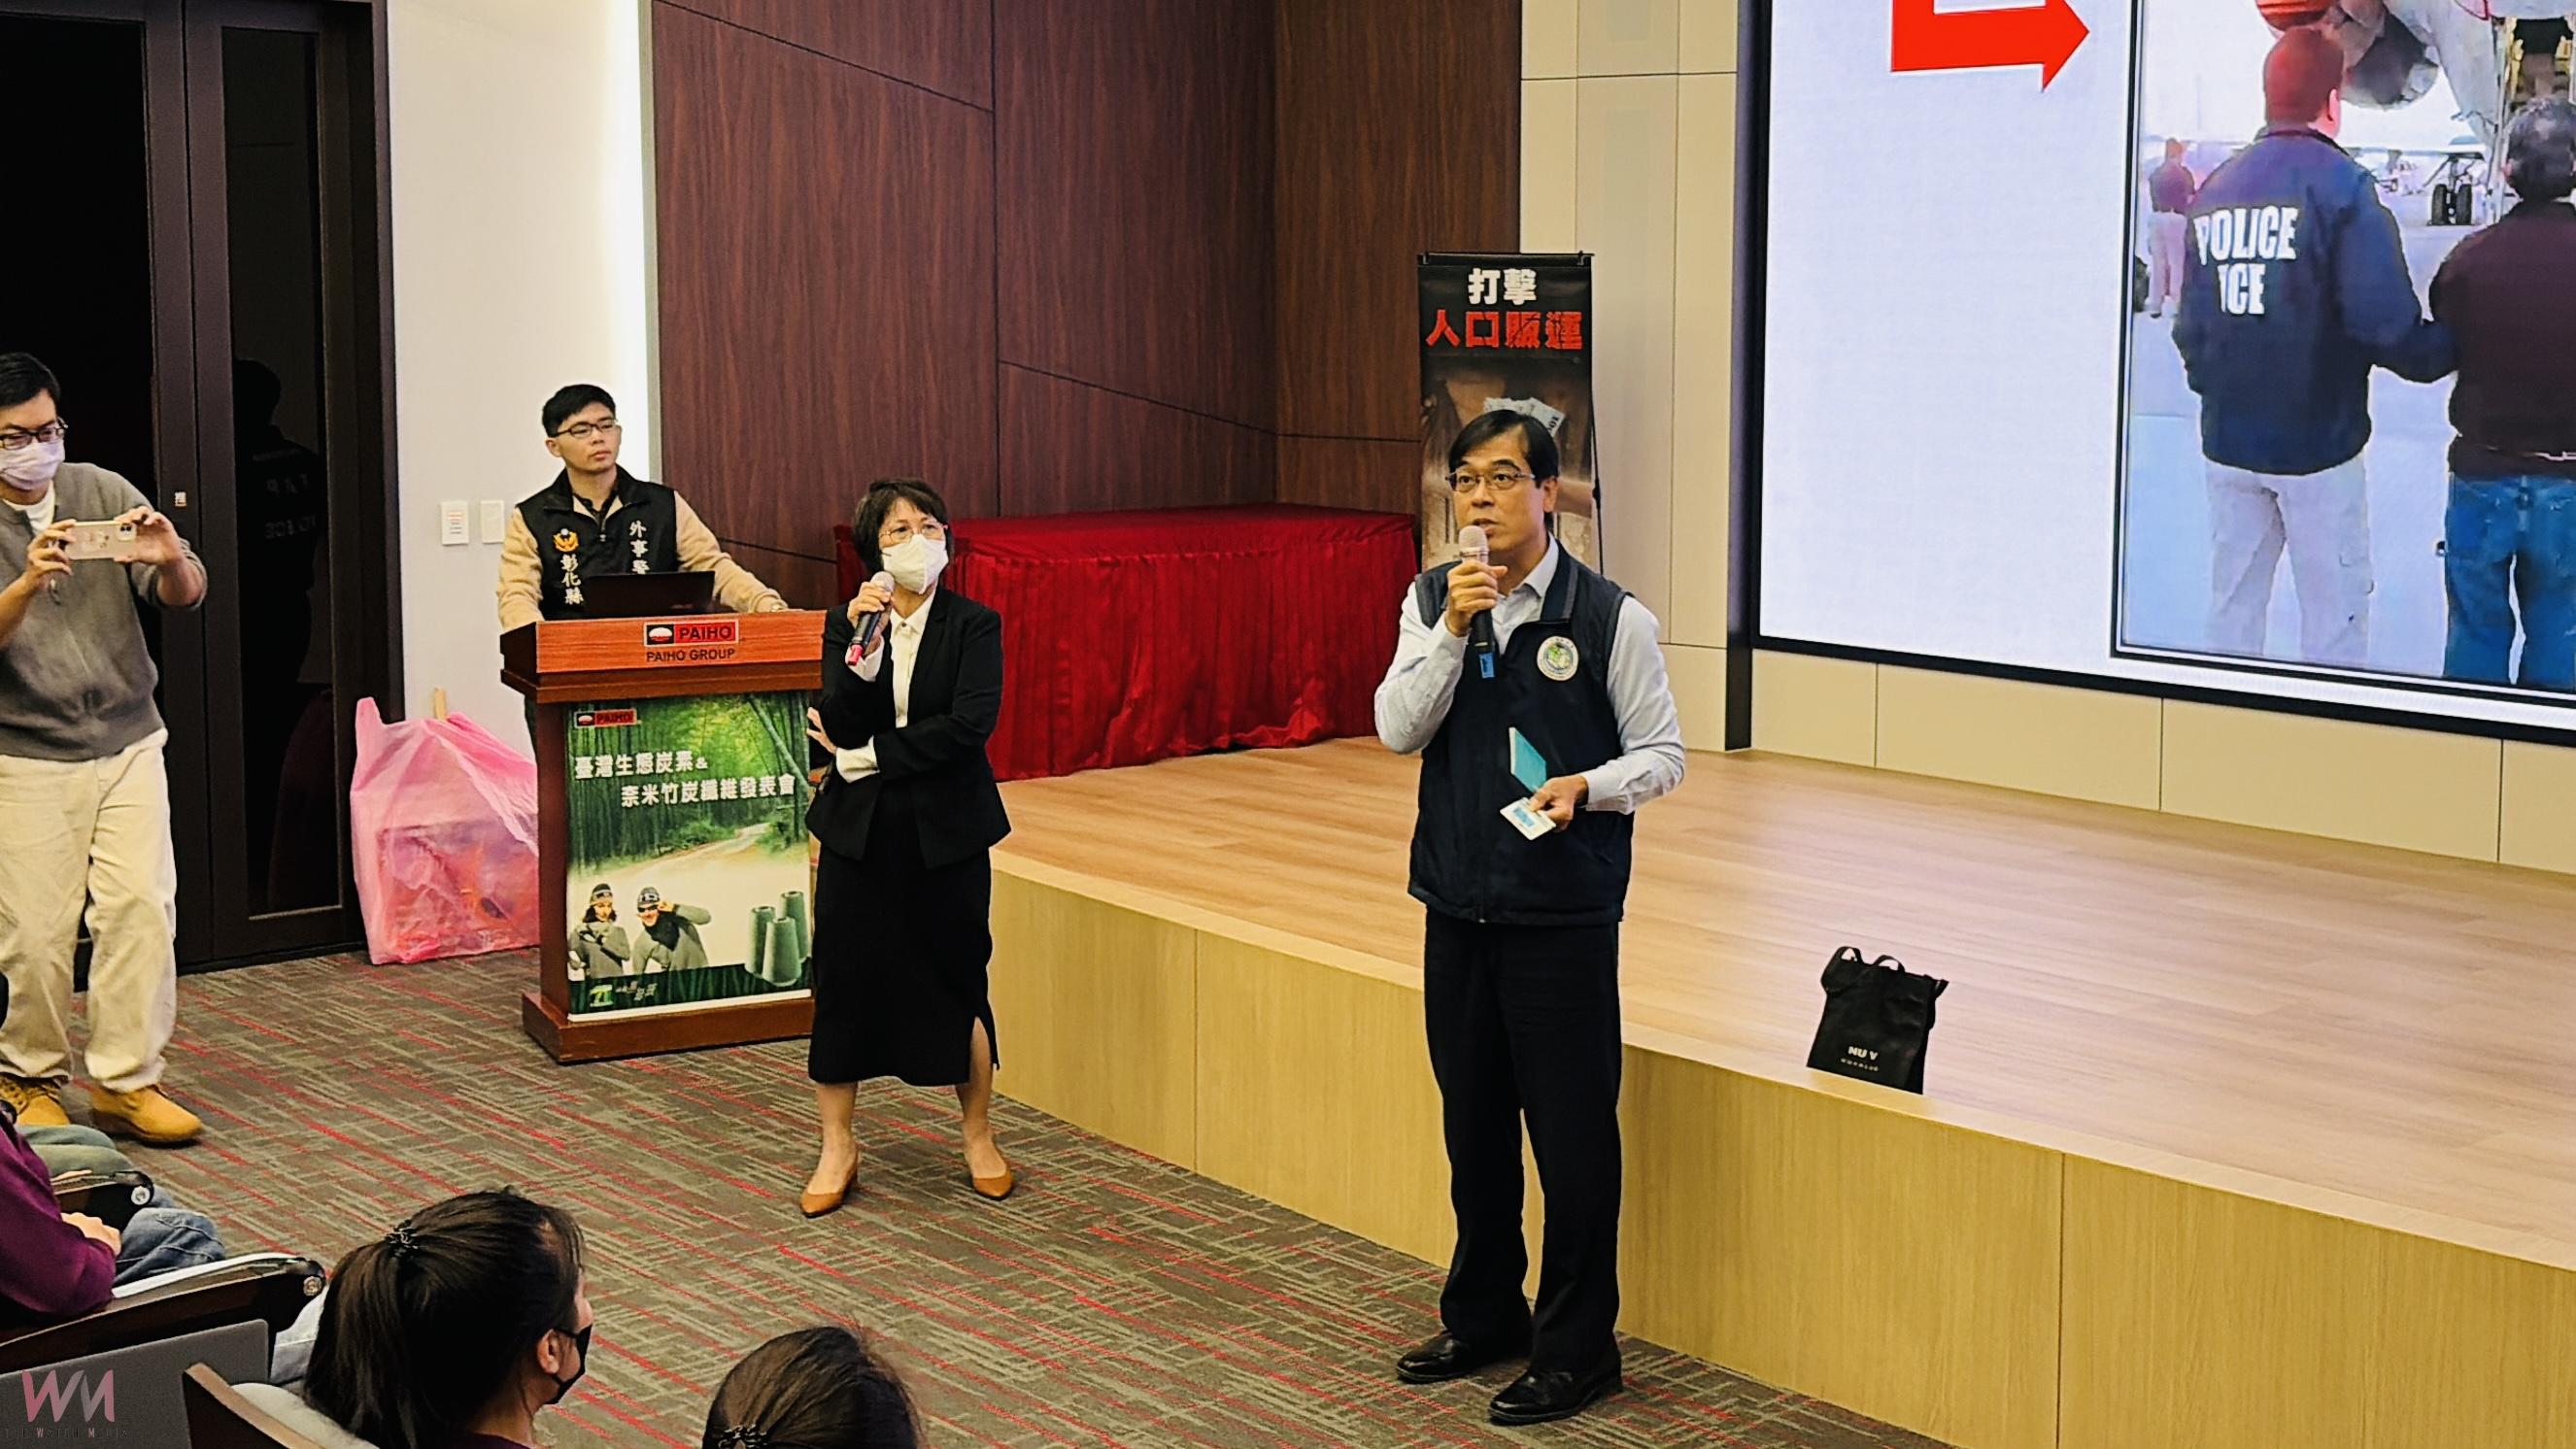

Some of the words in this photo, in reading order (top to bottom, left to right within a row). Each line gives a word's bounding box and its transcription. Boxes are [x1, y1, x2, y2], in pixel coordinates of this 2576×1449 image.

[2192, 205, 2299, 266] POLICE
[1468, 267, 1537, 306] 打擊
[2217, 263, 2266, 316] ICE
[1425, 309, 1583, 350] 人口販運
[559, 554, 584, 605] 彰化縣
[681, 625, 732, 641] PAIHO
[646, 650, 687, 661] PAIHO
[689, 648, 735, 660] GROUP
